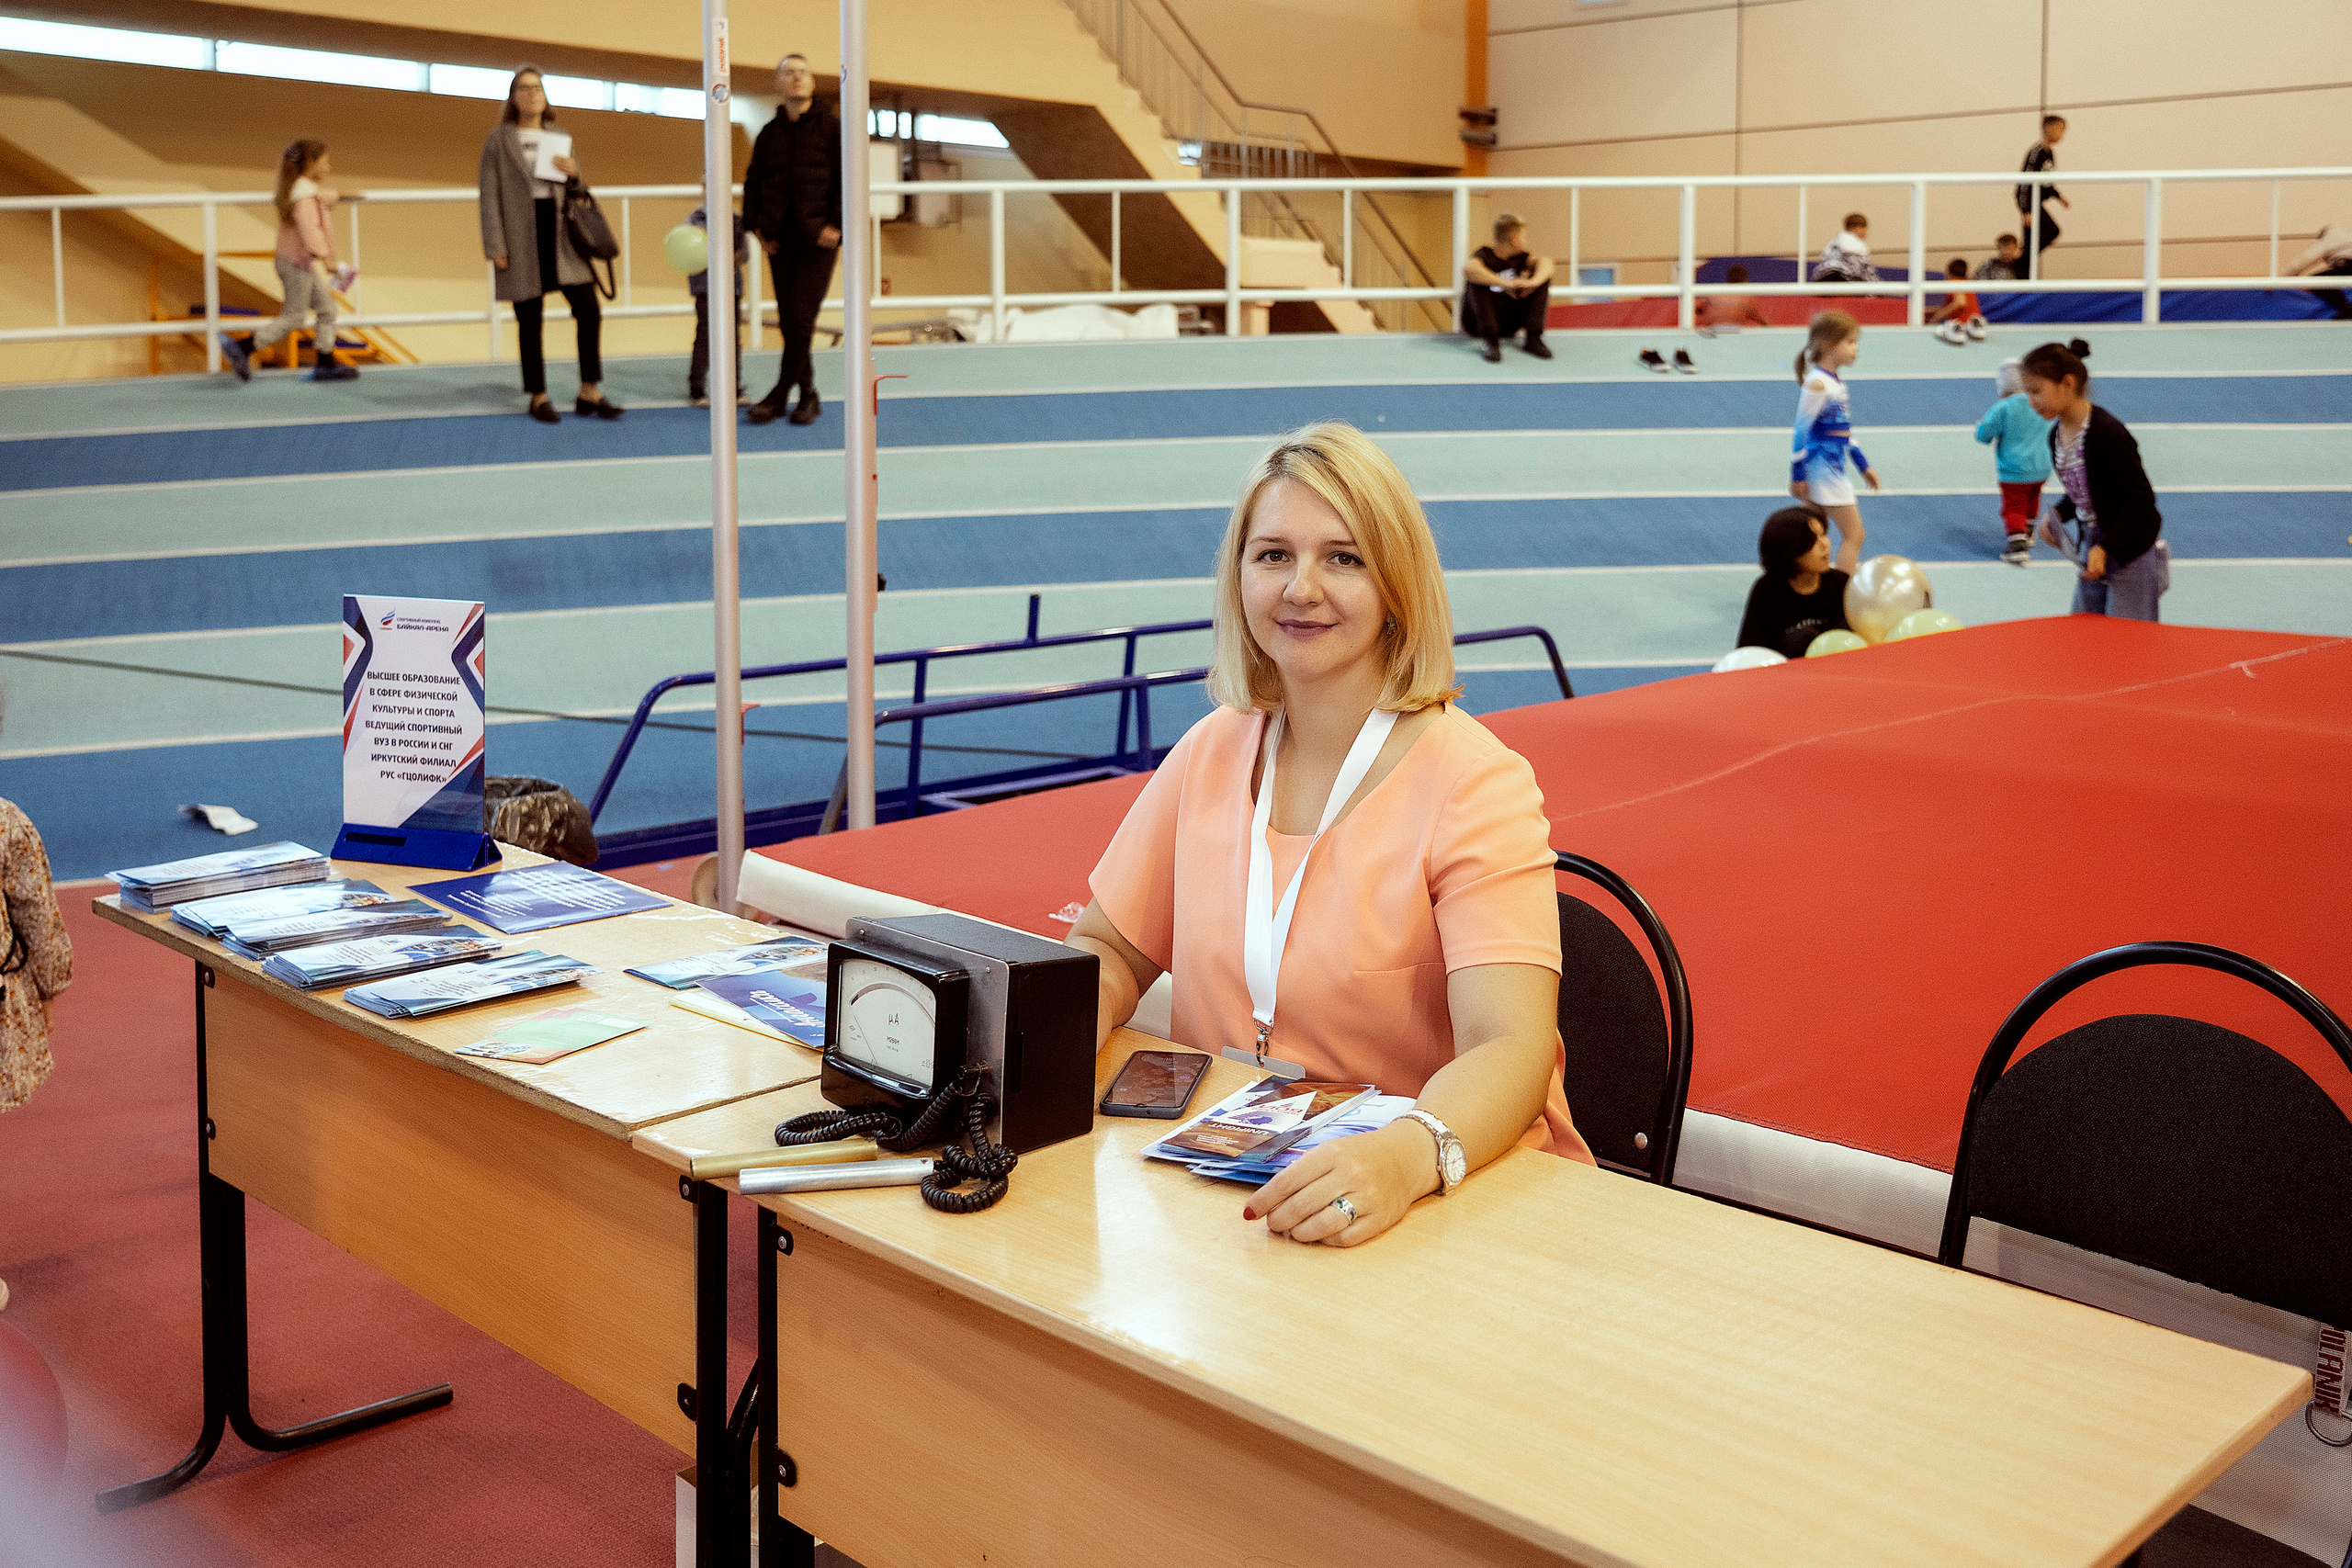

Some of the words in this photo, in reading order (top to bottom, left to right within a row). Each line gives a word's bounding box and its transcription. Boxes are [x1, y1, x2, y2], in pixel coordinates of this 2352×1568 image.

[396, 624, 449, 632] БАЙКАЛ-АРЕНА
[367, 671, 401, 682] ВЫСШЕЕ
[401, 673, 461, 685] ОБРАЗОВАНИЕ
[369, 687, 375, 696] В
[377, 688, 401, 698] СФЕРЕ
[403, 689, 458, 702] ФИЗИЧЕСКОЙ
[372, 704, 415, 716] КУЛЬТУРЫ
[416, 707, 423, 716] И
[424, 707, 456, 717] СПОРТА
[365, 720, 406, 732] ВЕДУЩИЙ
[407, 723, 463, 735] СПОРТИВНЫЙ
[374, 737, 390, 747] ВУЗ
[390, 739, 397, 747] В
[398, 739, 430, 749] РОССИИ
[431, 741, 437, 750] И
[438, 741, 454, 750] СНГ
[371, 753, 418, 765] ИРКУТСКИЙ
[420, 757, 457, 768] ФИЛИАЛ
[380, 770, 395, 779] РУС
[397, 772, 447, 783] «ГЦОЛИФК»
[2314, 1326, 2346, 1413] OLANIK
